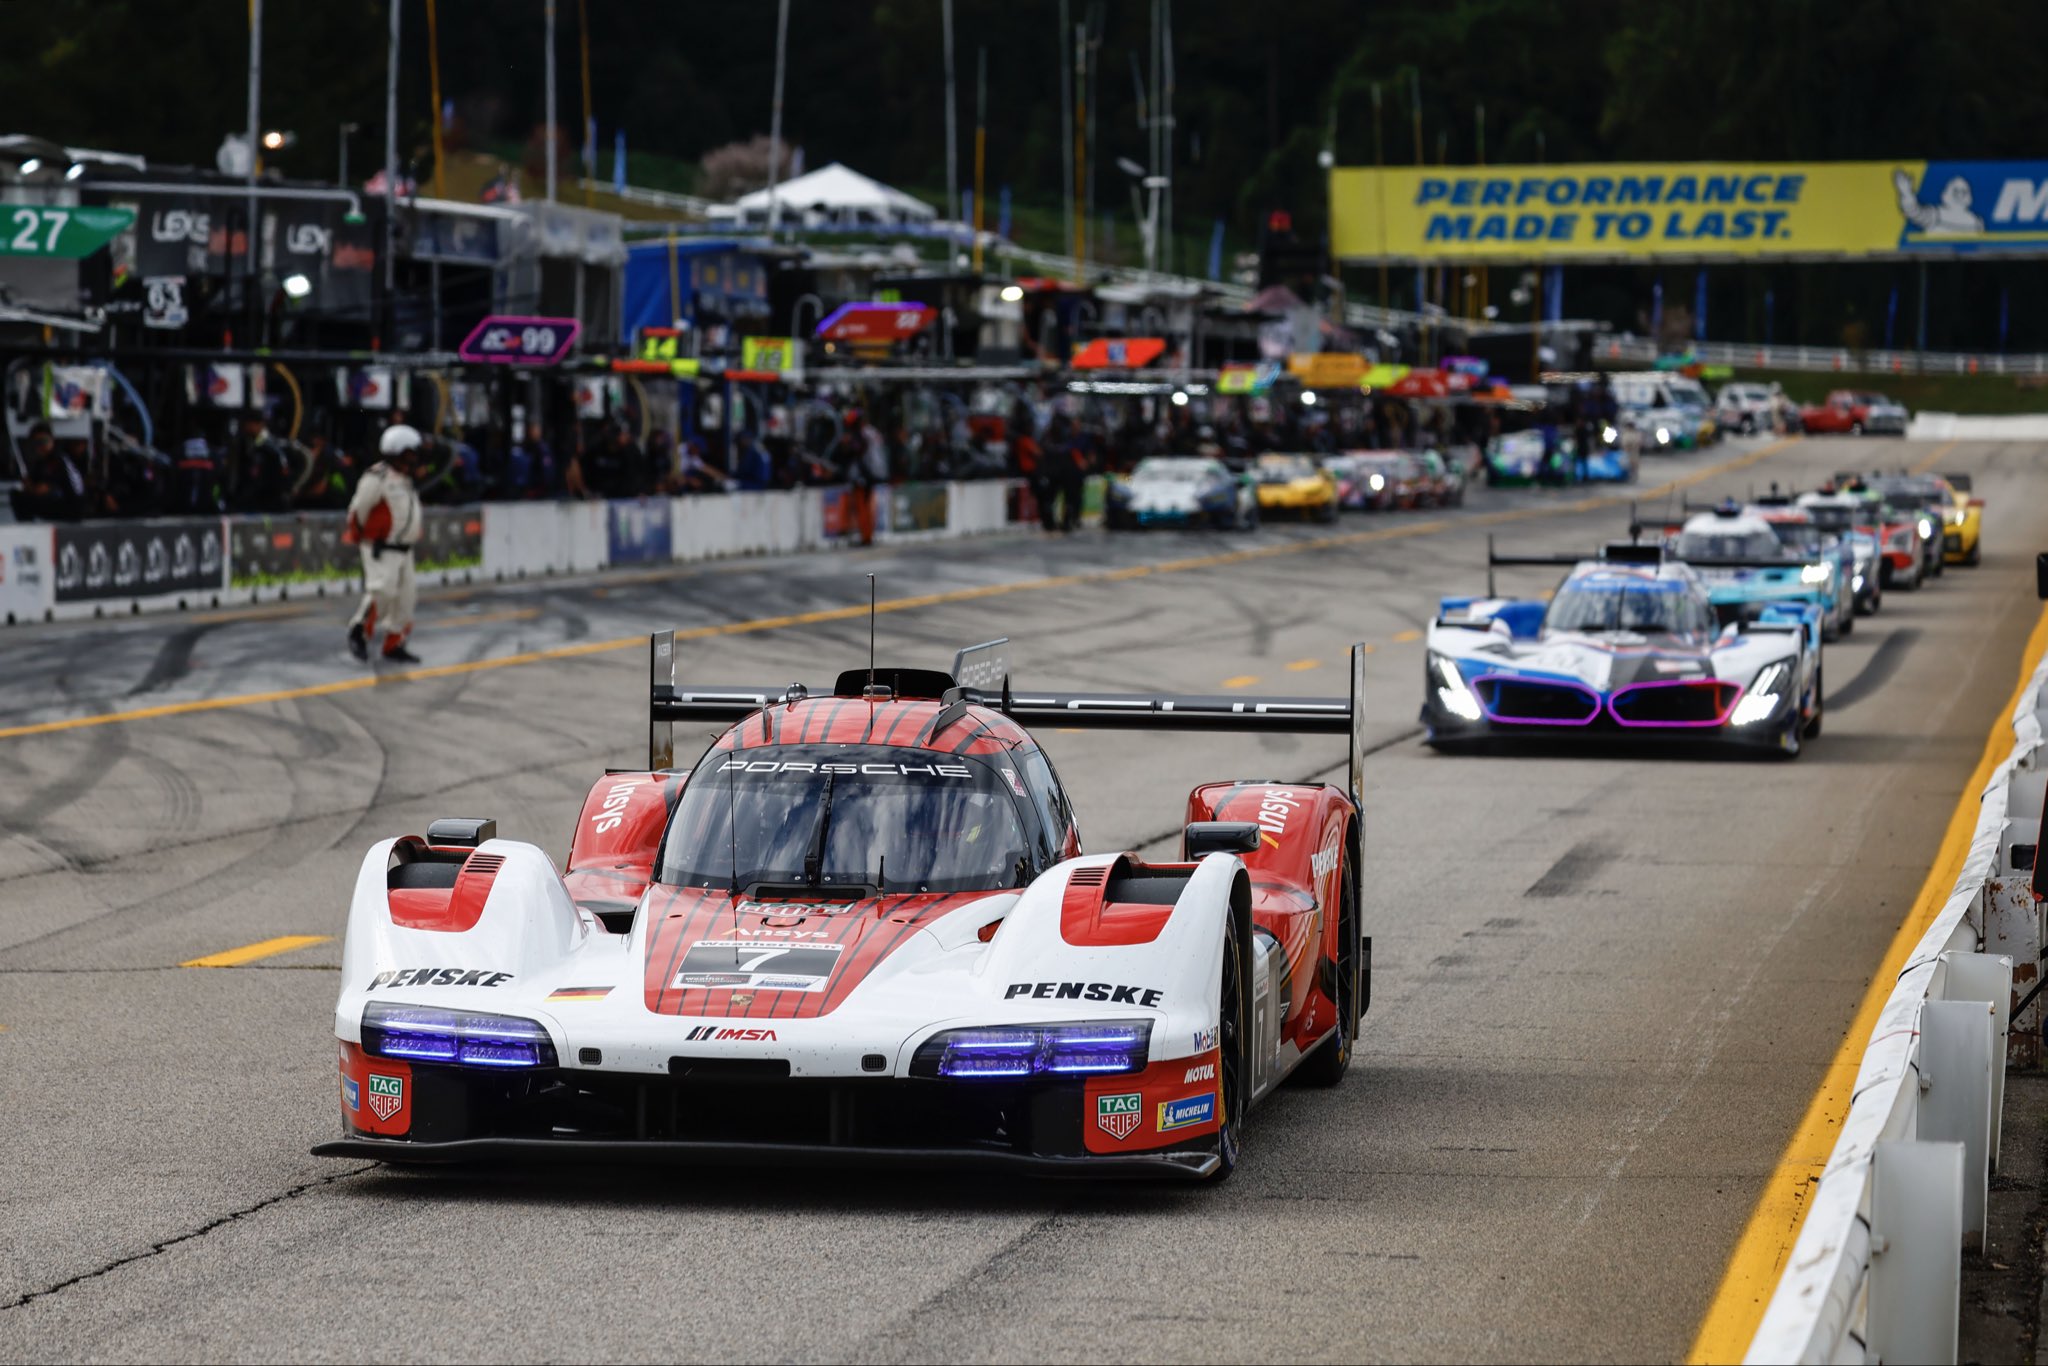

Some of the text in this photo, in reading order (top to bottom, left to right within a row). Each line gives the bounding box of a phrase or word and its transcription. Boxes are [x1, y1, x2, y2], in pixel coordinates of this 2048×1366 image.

[1415, 176, 1806, 206] PERFORMANCE
[1992, 178, 2048, 222] M
[11, 208, 70, 252] 27
[1425, 210, 1792, 241] MADE TO LAST.
[522, 327, 557, 353] 99
[717, 760, 973, 778] PORSCHE
[1258, 790, 1300, 849] Ansys
[722, 928, 829, 939] Ansys
[738, 948, 791, 972] 7
[367, 968, 515, 992] PENSKE
[1004, 982, 1163, 1008] PENSKE
[714, 1028, 777, 1042] IMSA
[1184, 1063, 1215, 1084] MOTUL
[371, 1078, 399, 1094] TAG
[370, 1094, 399, 1117] HEUER
[1102, 1097, 1138, 1112] TAG
[1175, 1102, 1210, 1120] MICHELIN
[1101, 1114, 1139, 1136] HEUER
